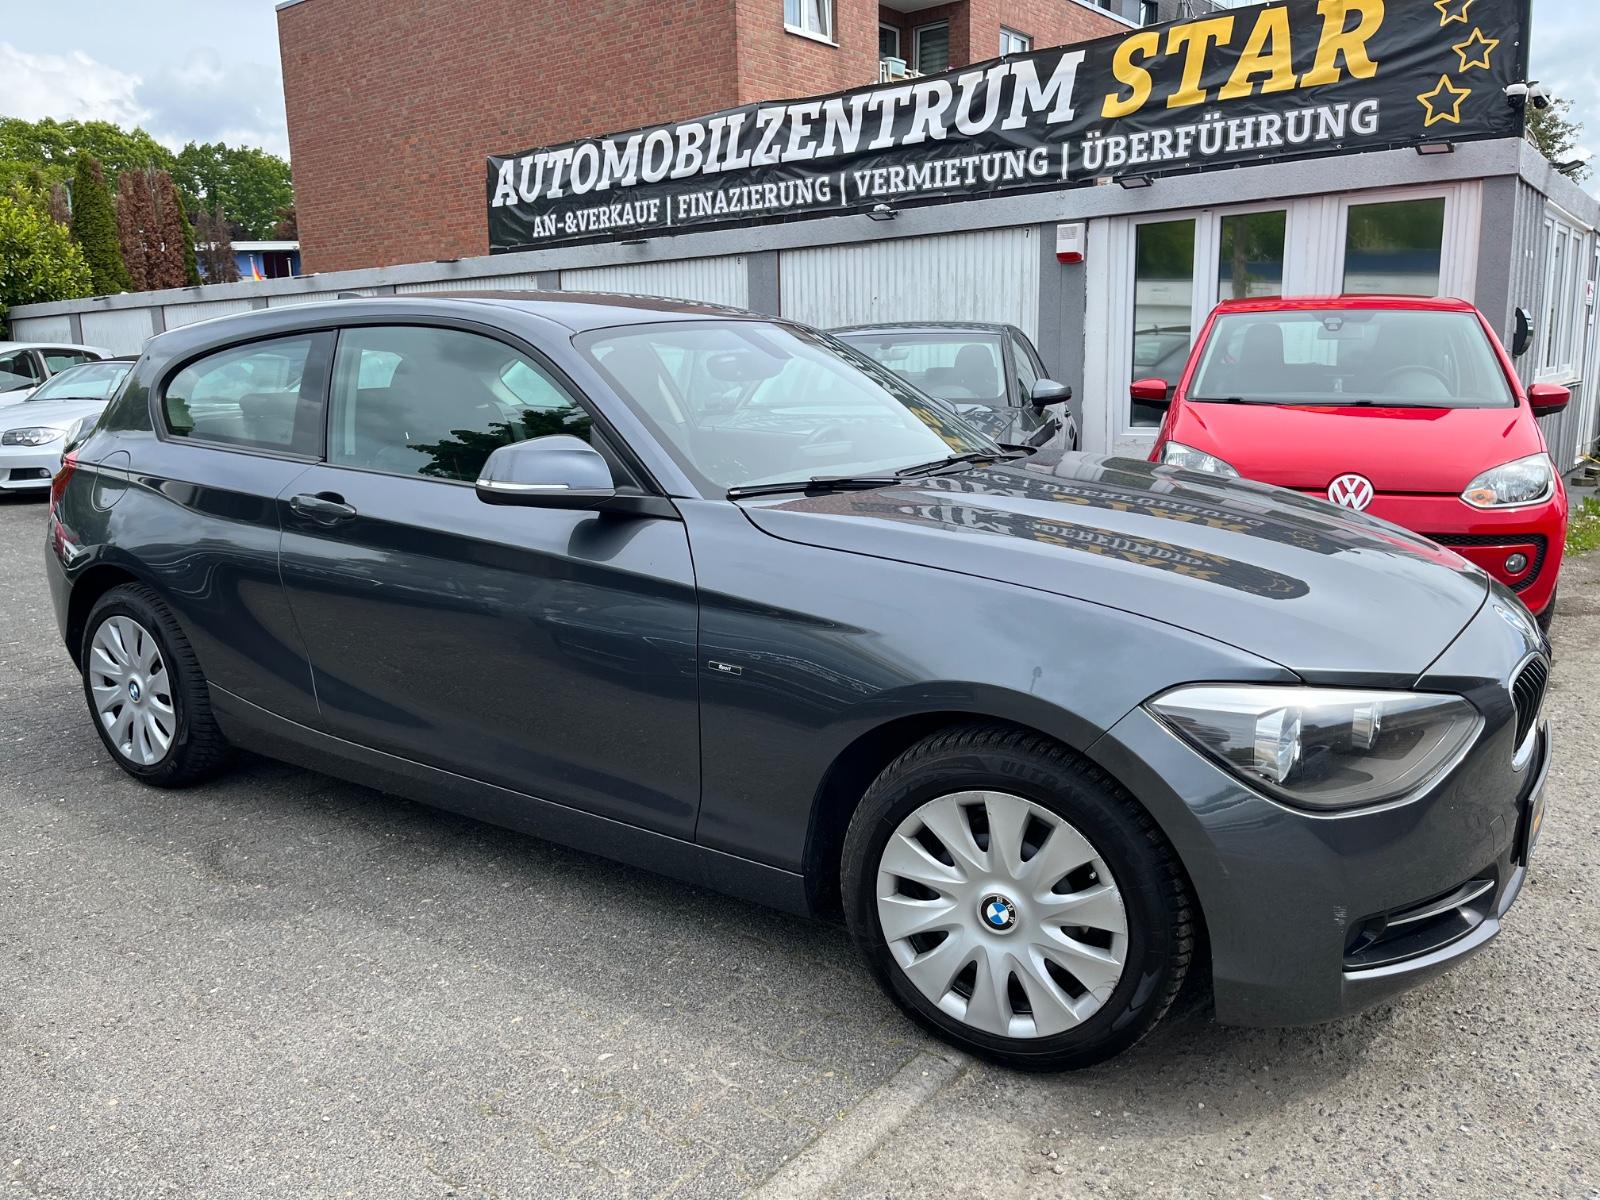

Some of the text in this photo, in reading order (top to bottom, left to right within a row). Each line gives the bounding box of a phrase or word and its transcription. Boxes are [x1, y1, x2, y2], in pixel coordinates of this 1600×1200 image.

[492, 0, 1385, 207] AUTOMOBILZENTRUM STAR
[532, 100, 1379, 238] AN-&VERKAUF FINAZIERUNG VERMIETUNG ÜBERFÜHRUNG
